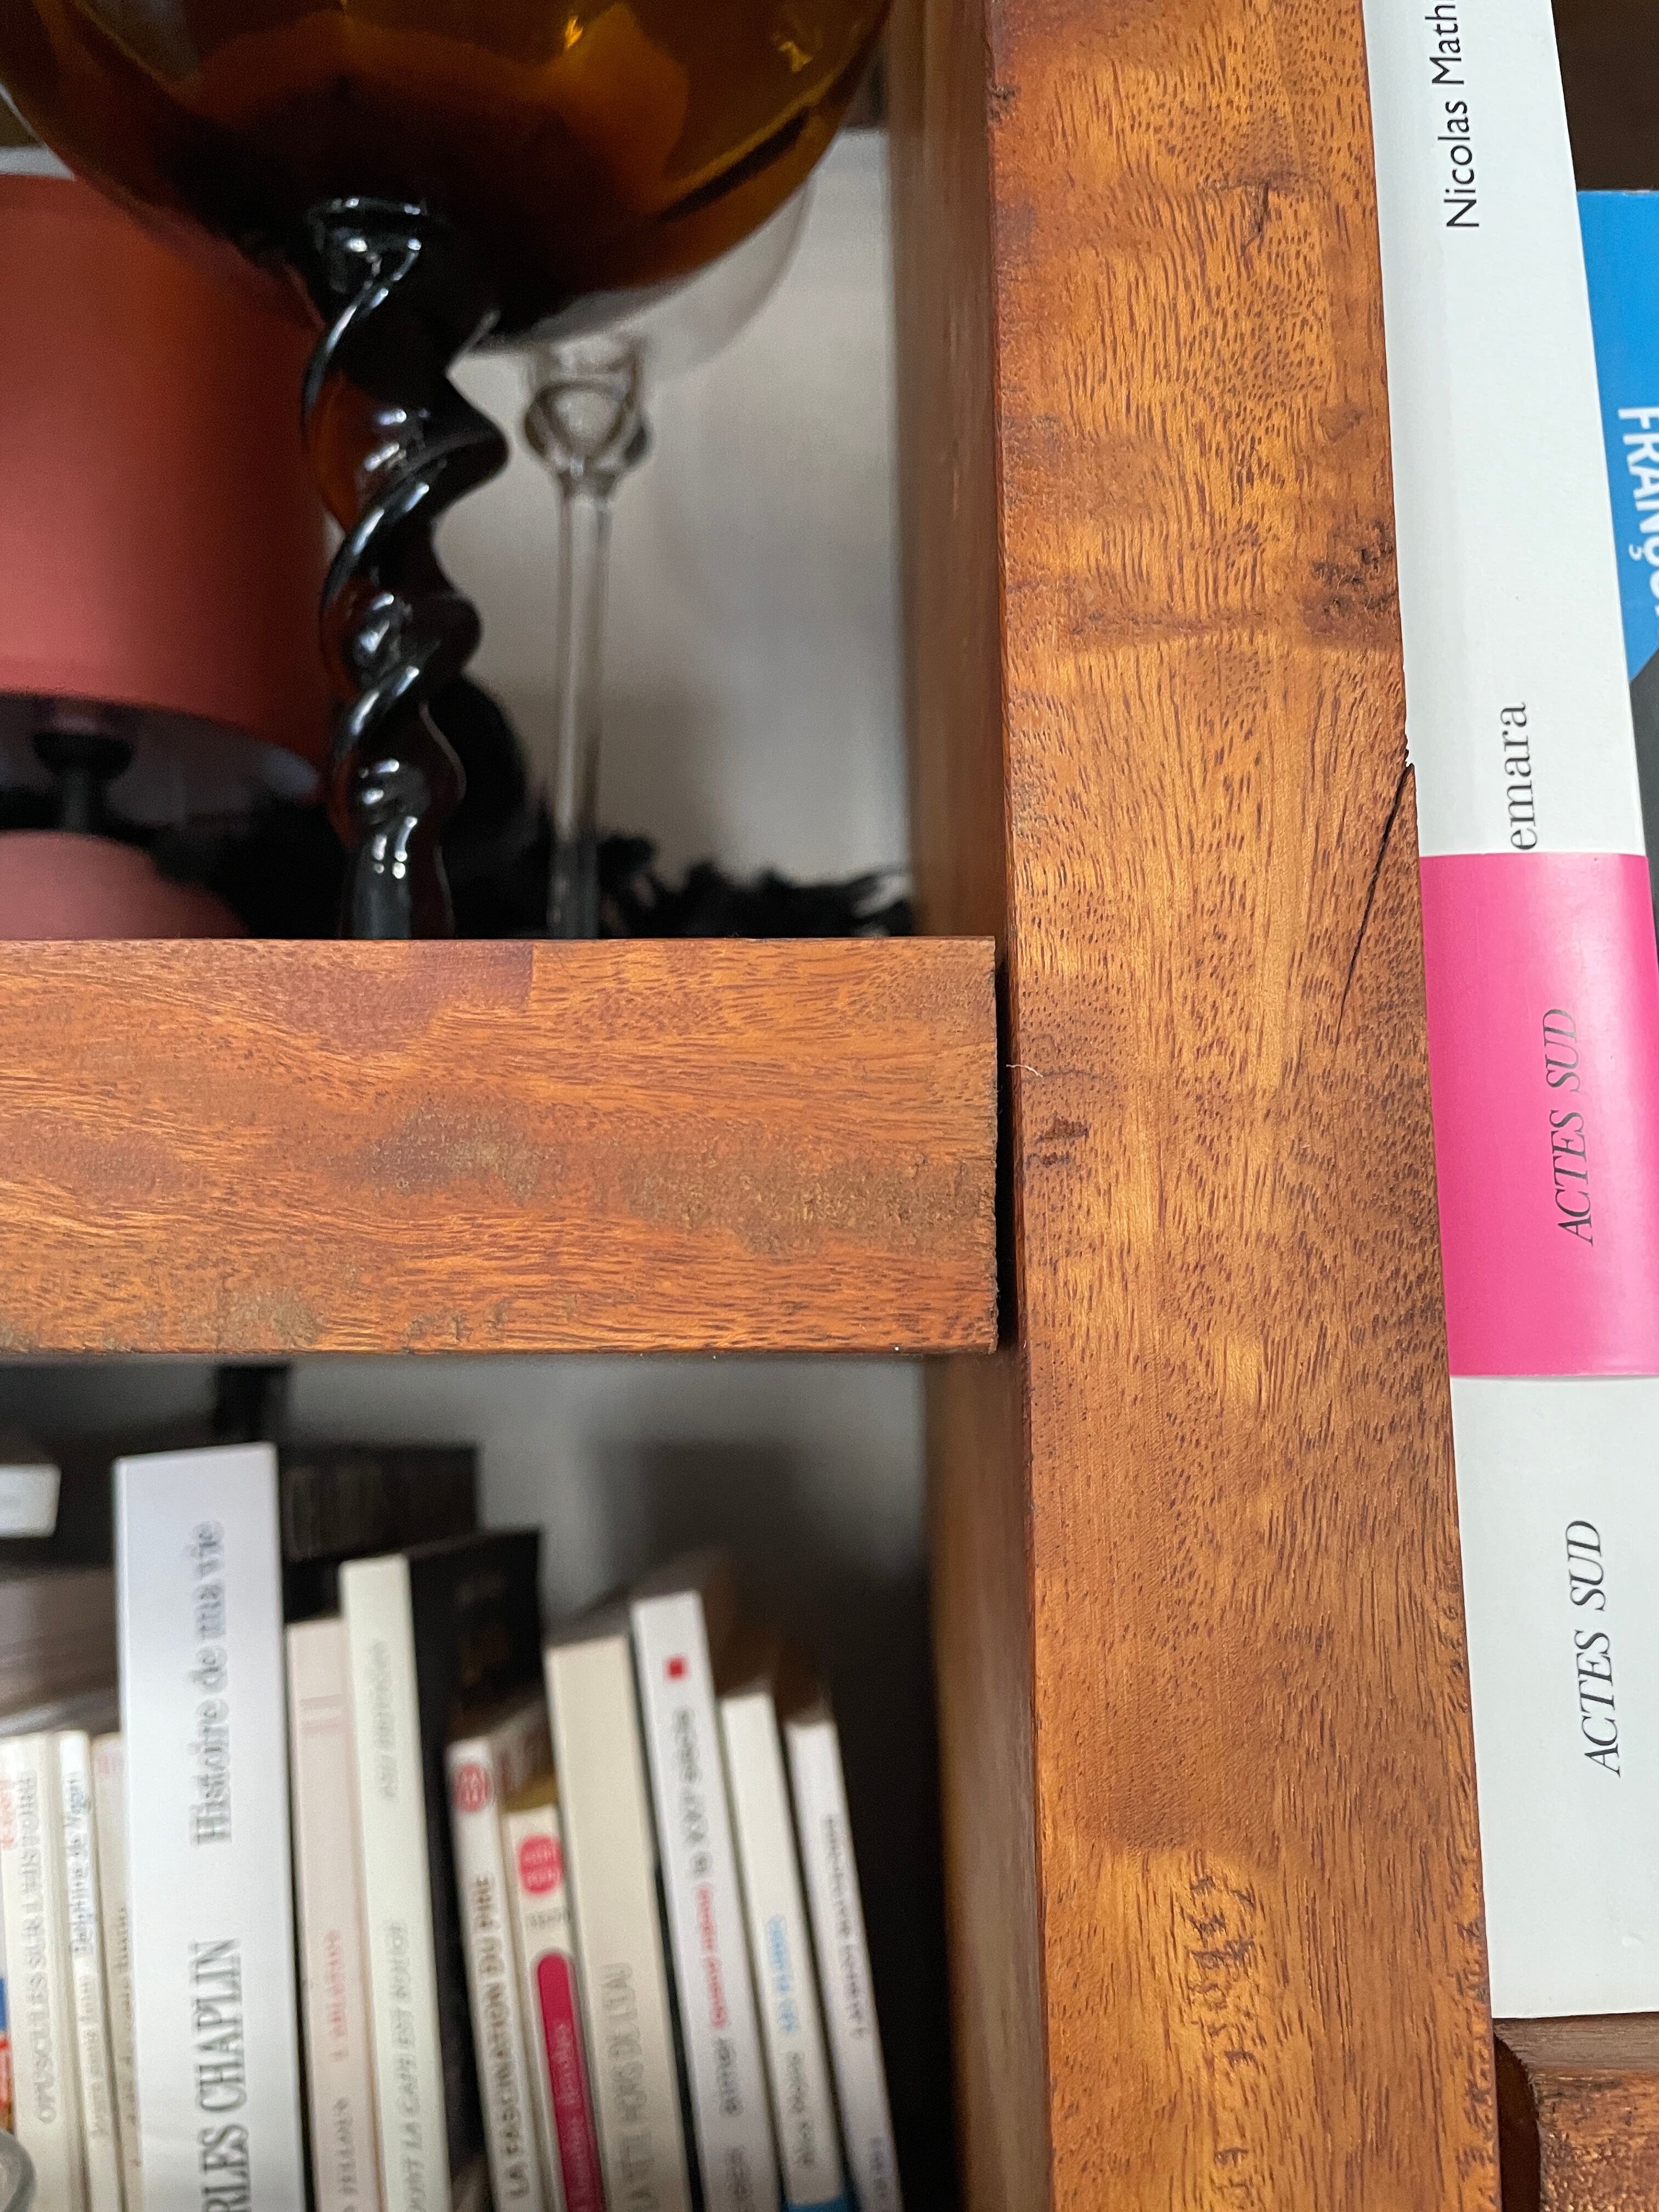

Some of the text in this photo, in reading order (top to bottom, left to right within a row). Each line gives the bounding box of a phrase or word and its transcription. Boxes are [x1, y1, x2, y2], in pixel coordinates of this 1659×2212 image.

[1437, 100, 1479, 228] Nicolas
[1500, 702, 1538, 850] emara
[1542, 1008, 1593, 1246] ACTES SUD
[185, 1521, 233, 1845] Histoire de ma vie
[1565, 1520, 1621, 1778] ACTES SUD
[188, 1938, 246, 2112] CHAPLIN
[476, 1937, 501, 1976] DU
[483, 1981, 522, 2157] FASCINATION
